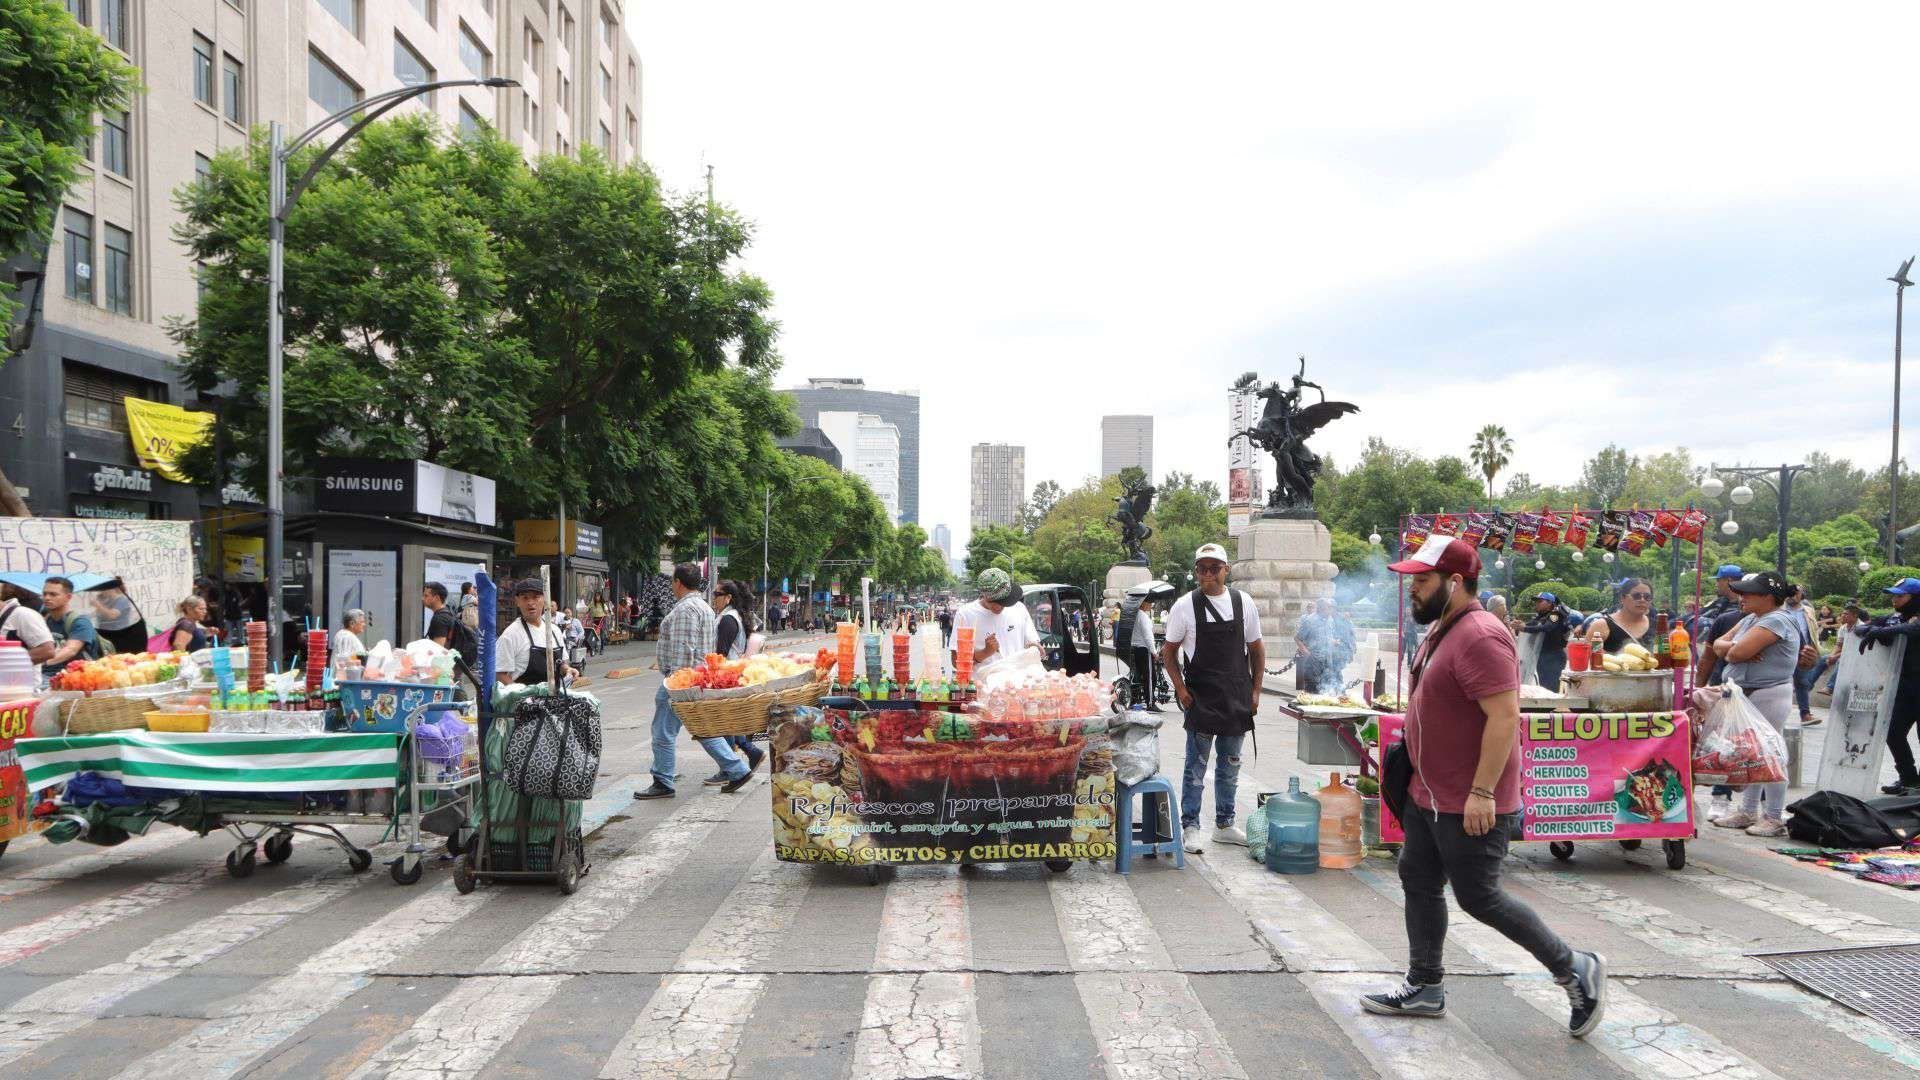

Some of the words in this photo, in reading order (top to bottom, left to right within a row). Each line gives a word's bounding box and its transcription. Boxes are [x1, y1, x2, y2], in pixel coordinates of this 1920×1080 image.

[93, 468, 152, 492] gandhi
[326, 476, 404, 491] SAMSUNG
[75, 505, 94, 517] Una
[1518, 523, 1537, 532] Doritos
[1528, 712, 1676, 741] ELOTES
[1533, 748, 1576, 760] ASADOS
[1534, 766, 1587, 779] HERVIDOS
[1534, 785, 1588, 798] ESQUITES
[790, 793, 935, 822] Refrescos
[1535, 802, 1618, 817] TOSTIESQUITES
[840, 821, 897, 837] squirt,
[970, 823, 985, 836] y
[987, 819, 1034, 833] agua
[1036, 813, 1111, 829] mineral
[1534, 821, 1614, 835] DORIESQUITES
[779, 845, 855, 864] PAPAS,
[859, 846, 947, 863] CHETOS
[952, 849, 965, 864] y
[969, 841, 1117, 860] CHICHARRON
